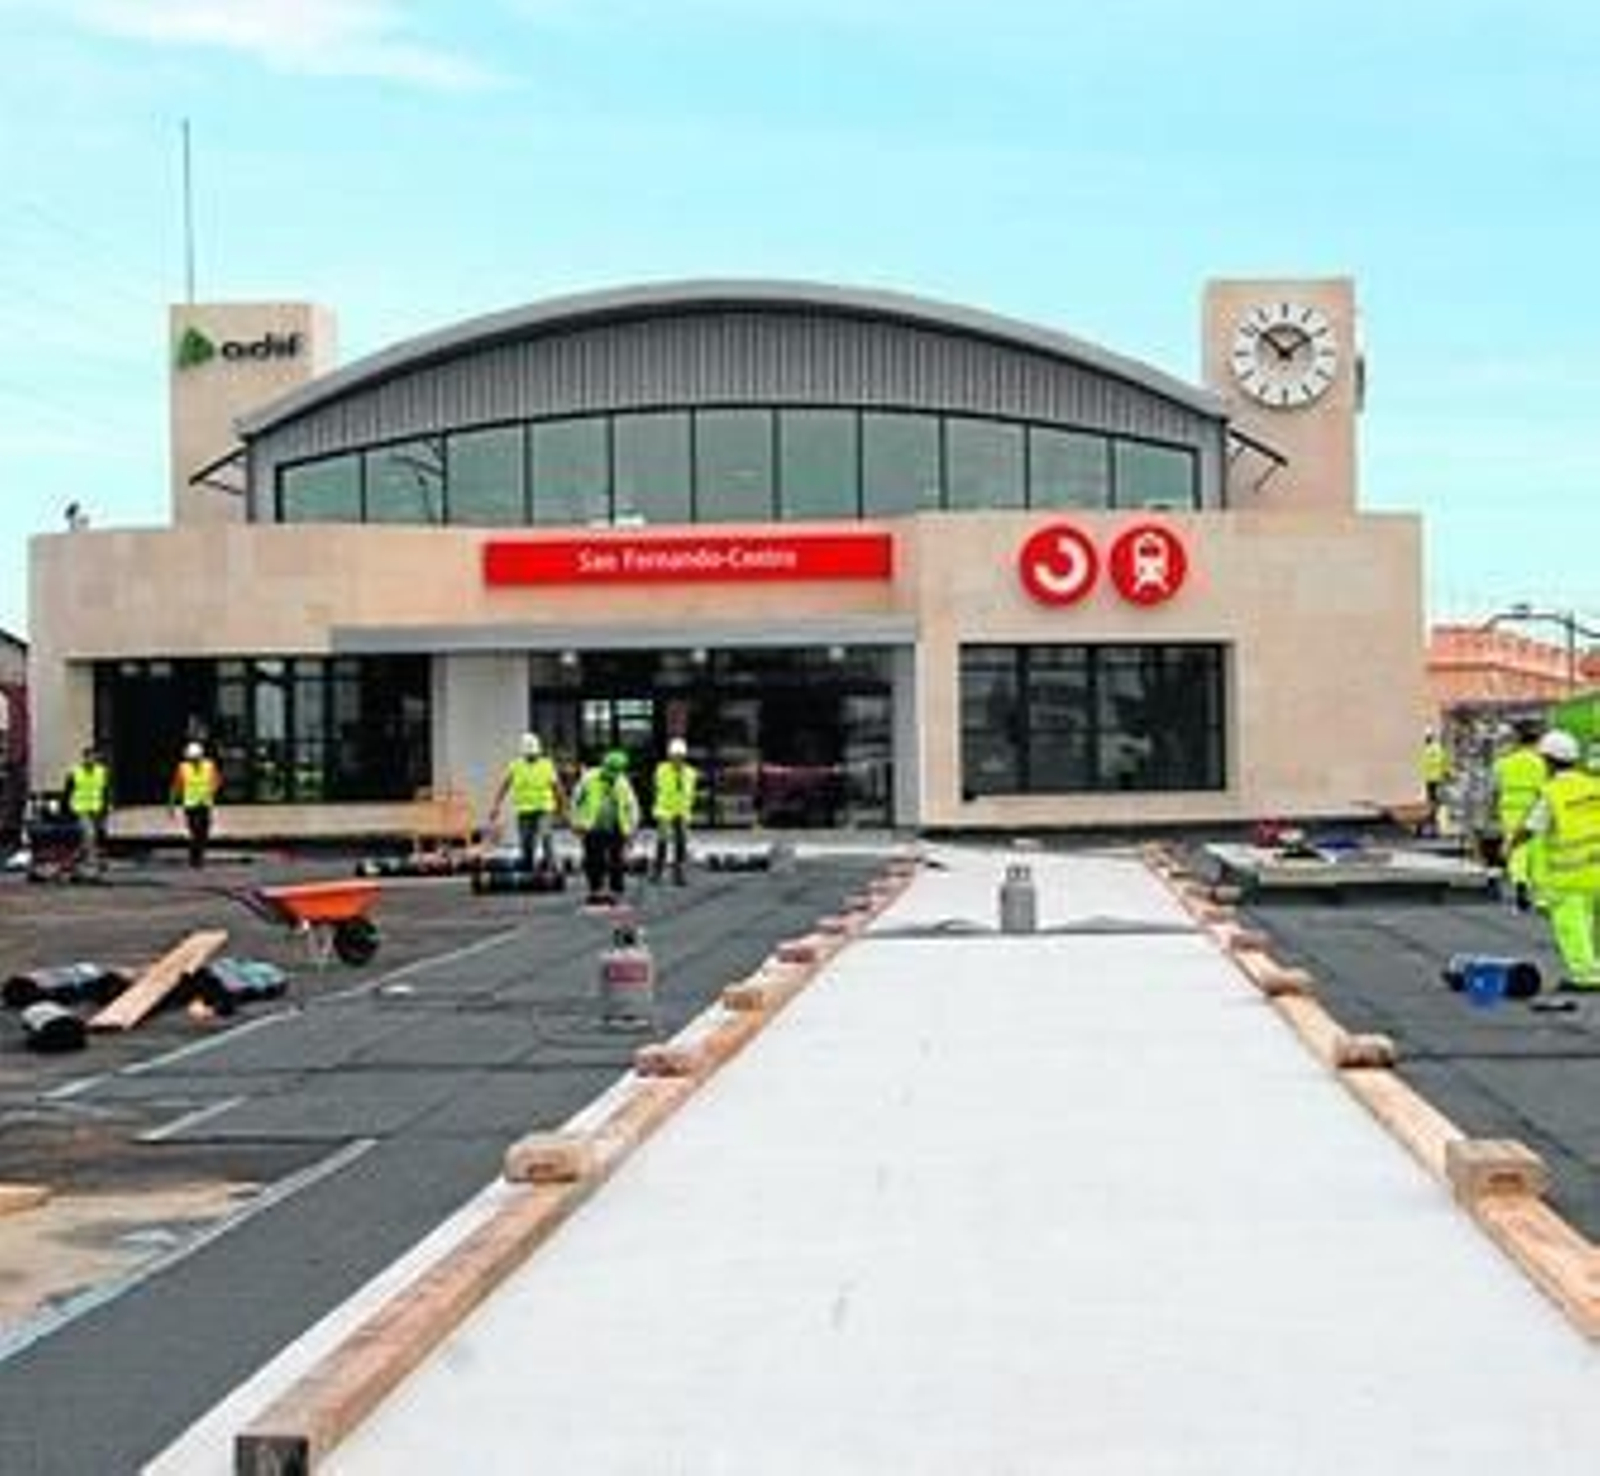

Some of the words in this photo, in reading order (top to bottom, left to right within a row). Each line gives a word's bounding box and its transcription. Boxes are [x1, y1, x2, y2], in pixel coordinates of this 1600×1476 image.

[221, 331, 303, 361] adif
[578, 548, 618, 572] San
[622, 547, 797, 571] Fernando-Centro
